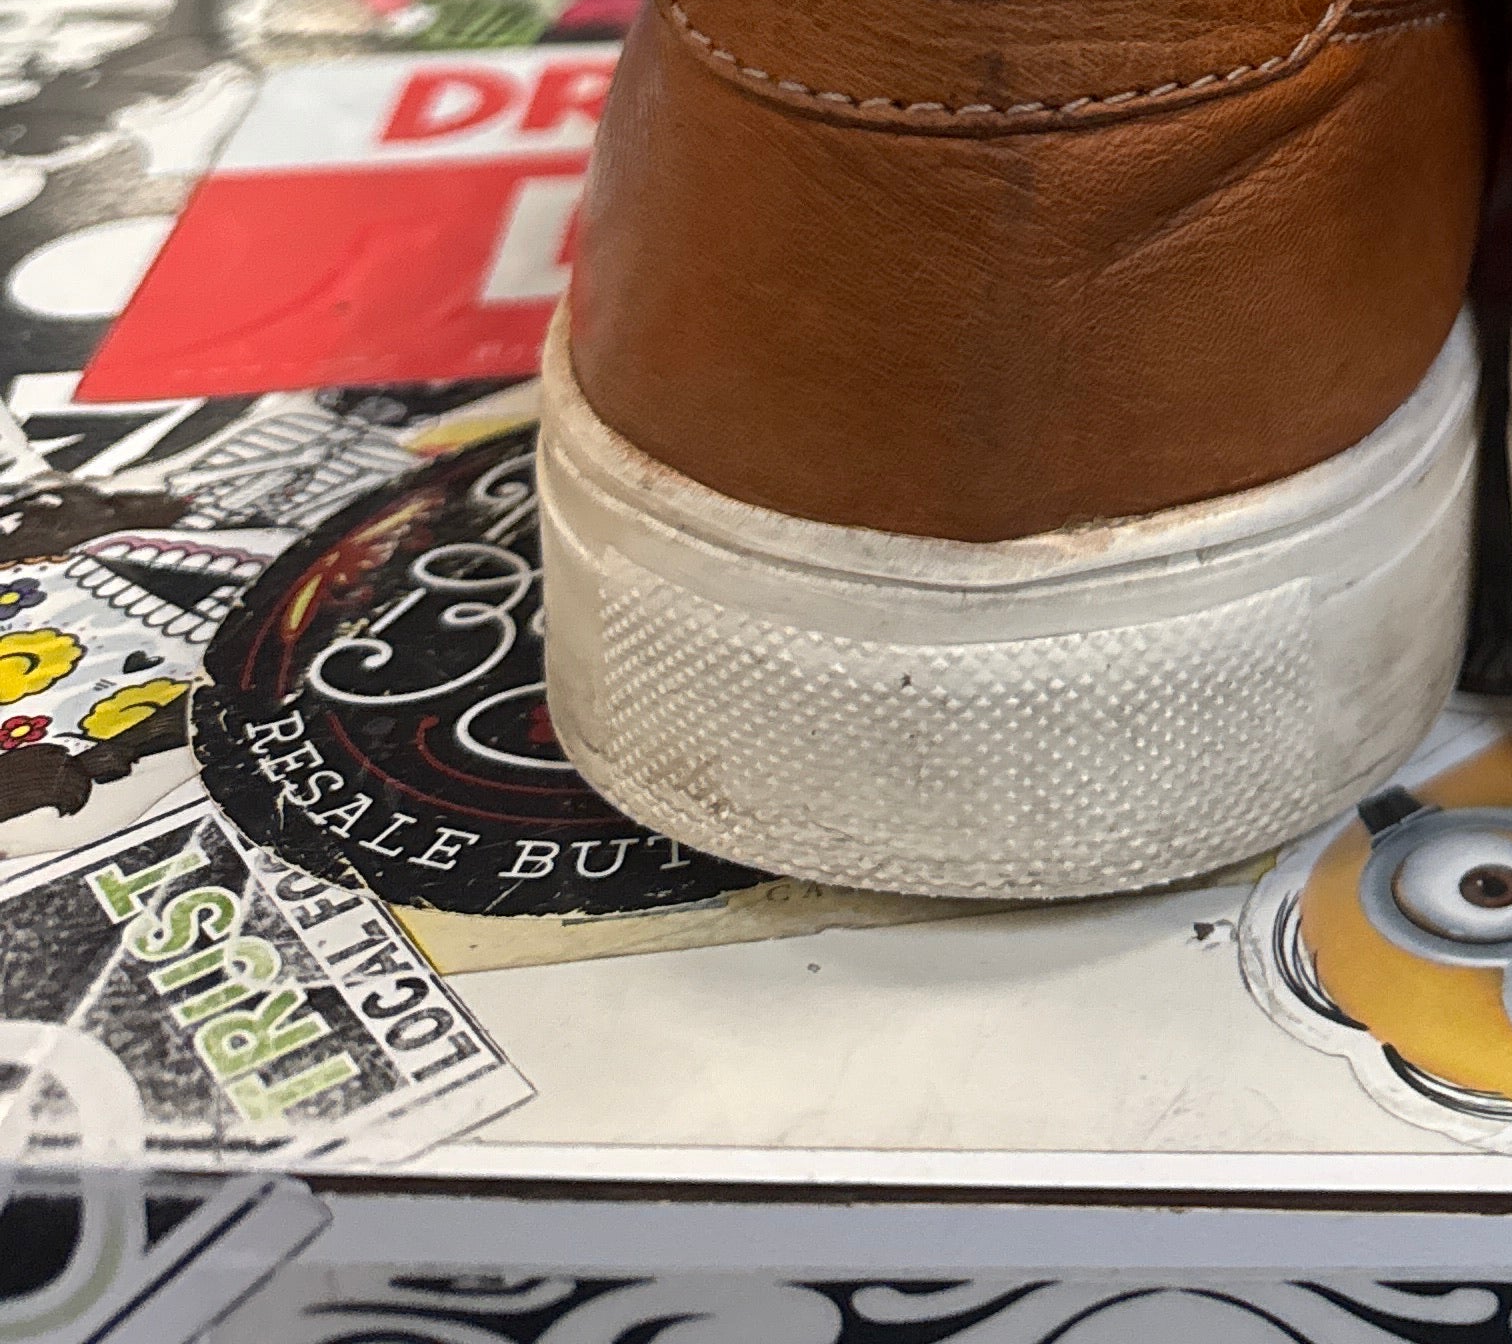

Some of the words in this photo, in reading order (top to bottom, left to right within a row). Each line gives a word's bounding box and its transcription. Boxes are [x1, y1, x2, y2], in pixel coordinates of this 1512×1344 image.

[244, 710, 480, 870] RESALE
[85, 848, 360, 1126] TRUST
[324, 918, 481, 1082] LOCAL
